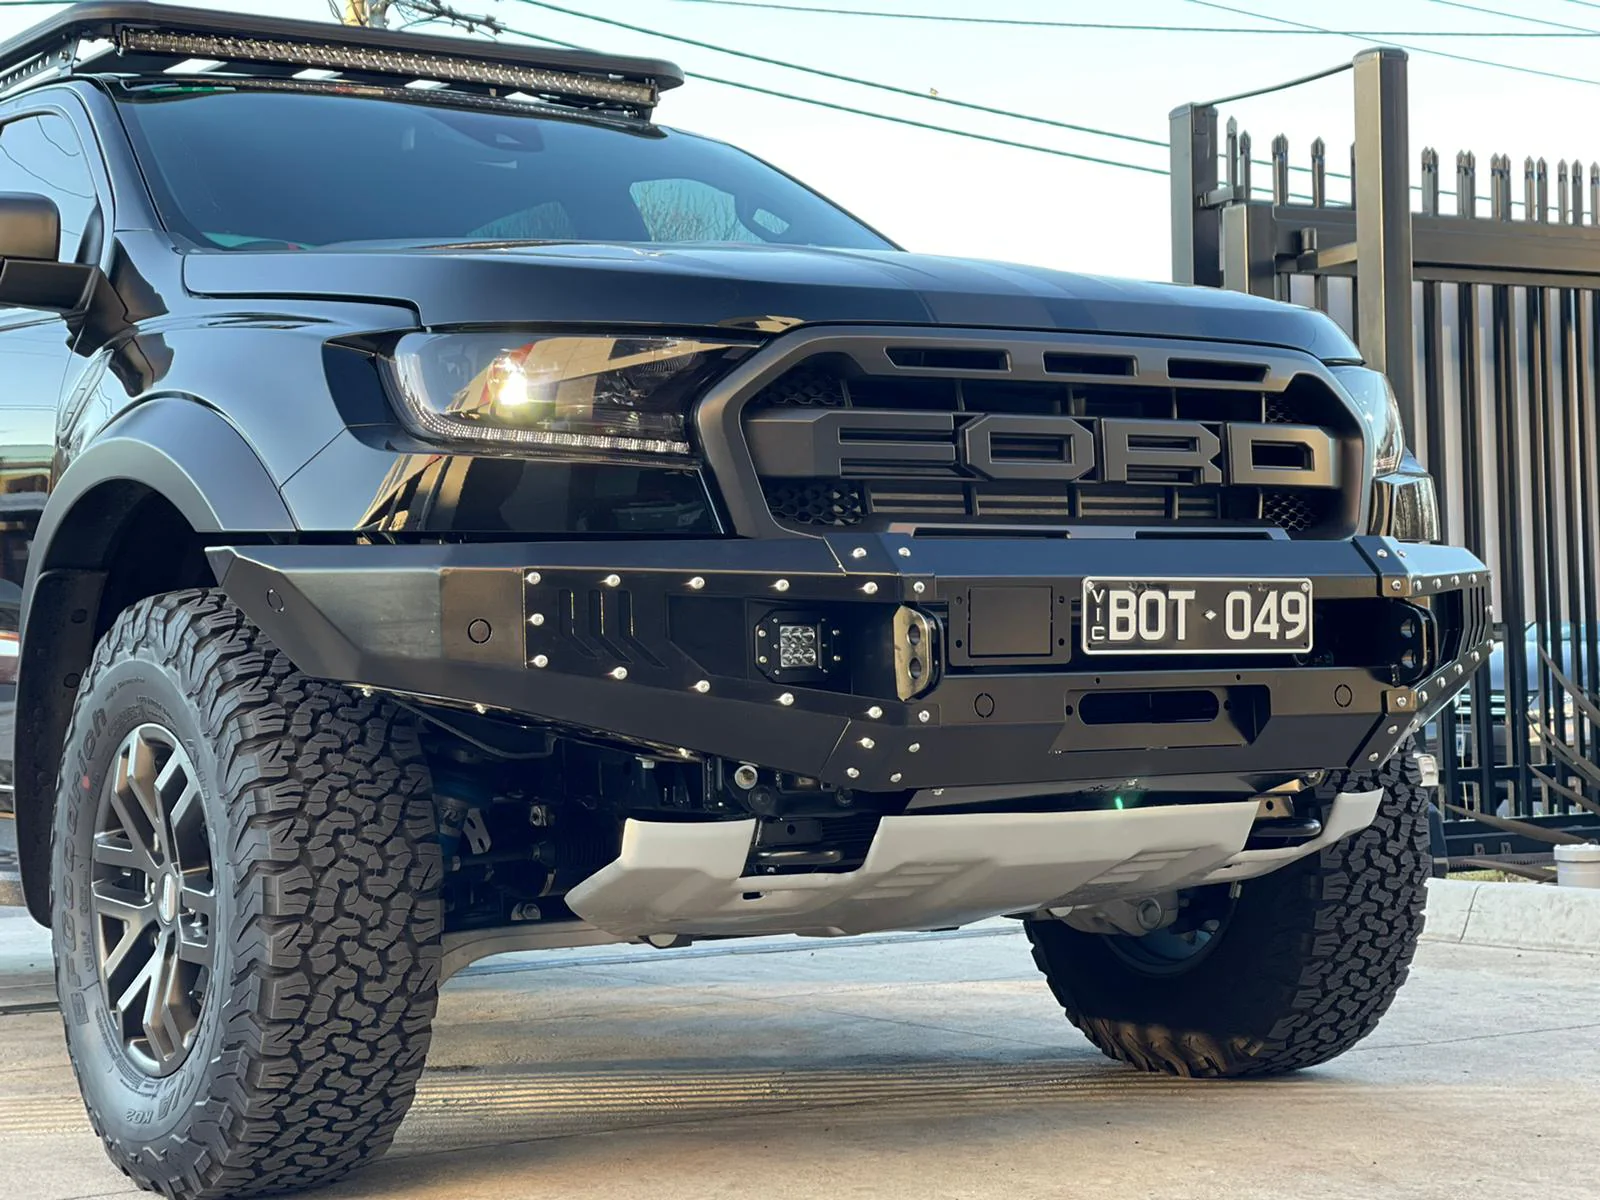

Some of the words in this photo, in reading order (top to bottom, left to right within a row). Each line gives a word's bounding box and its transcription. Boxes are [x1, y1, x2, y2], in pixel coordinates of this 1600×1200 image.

[812, 410, 1338, 487] FORD
[1091, 589, 1105, 641] VIC
[1108, 590, 1196, 641] BOT
[1225, 590, 1307, 640] 049
